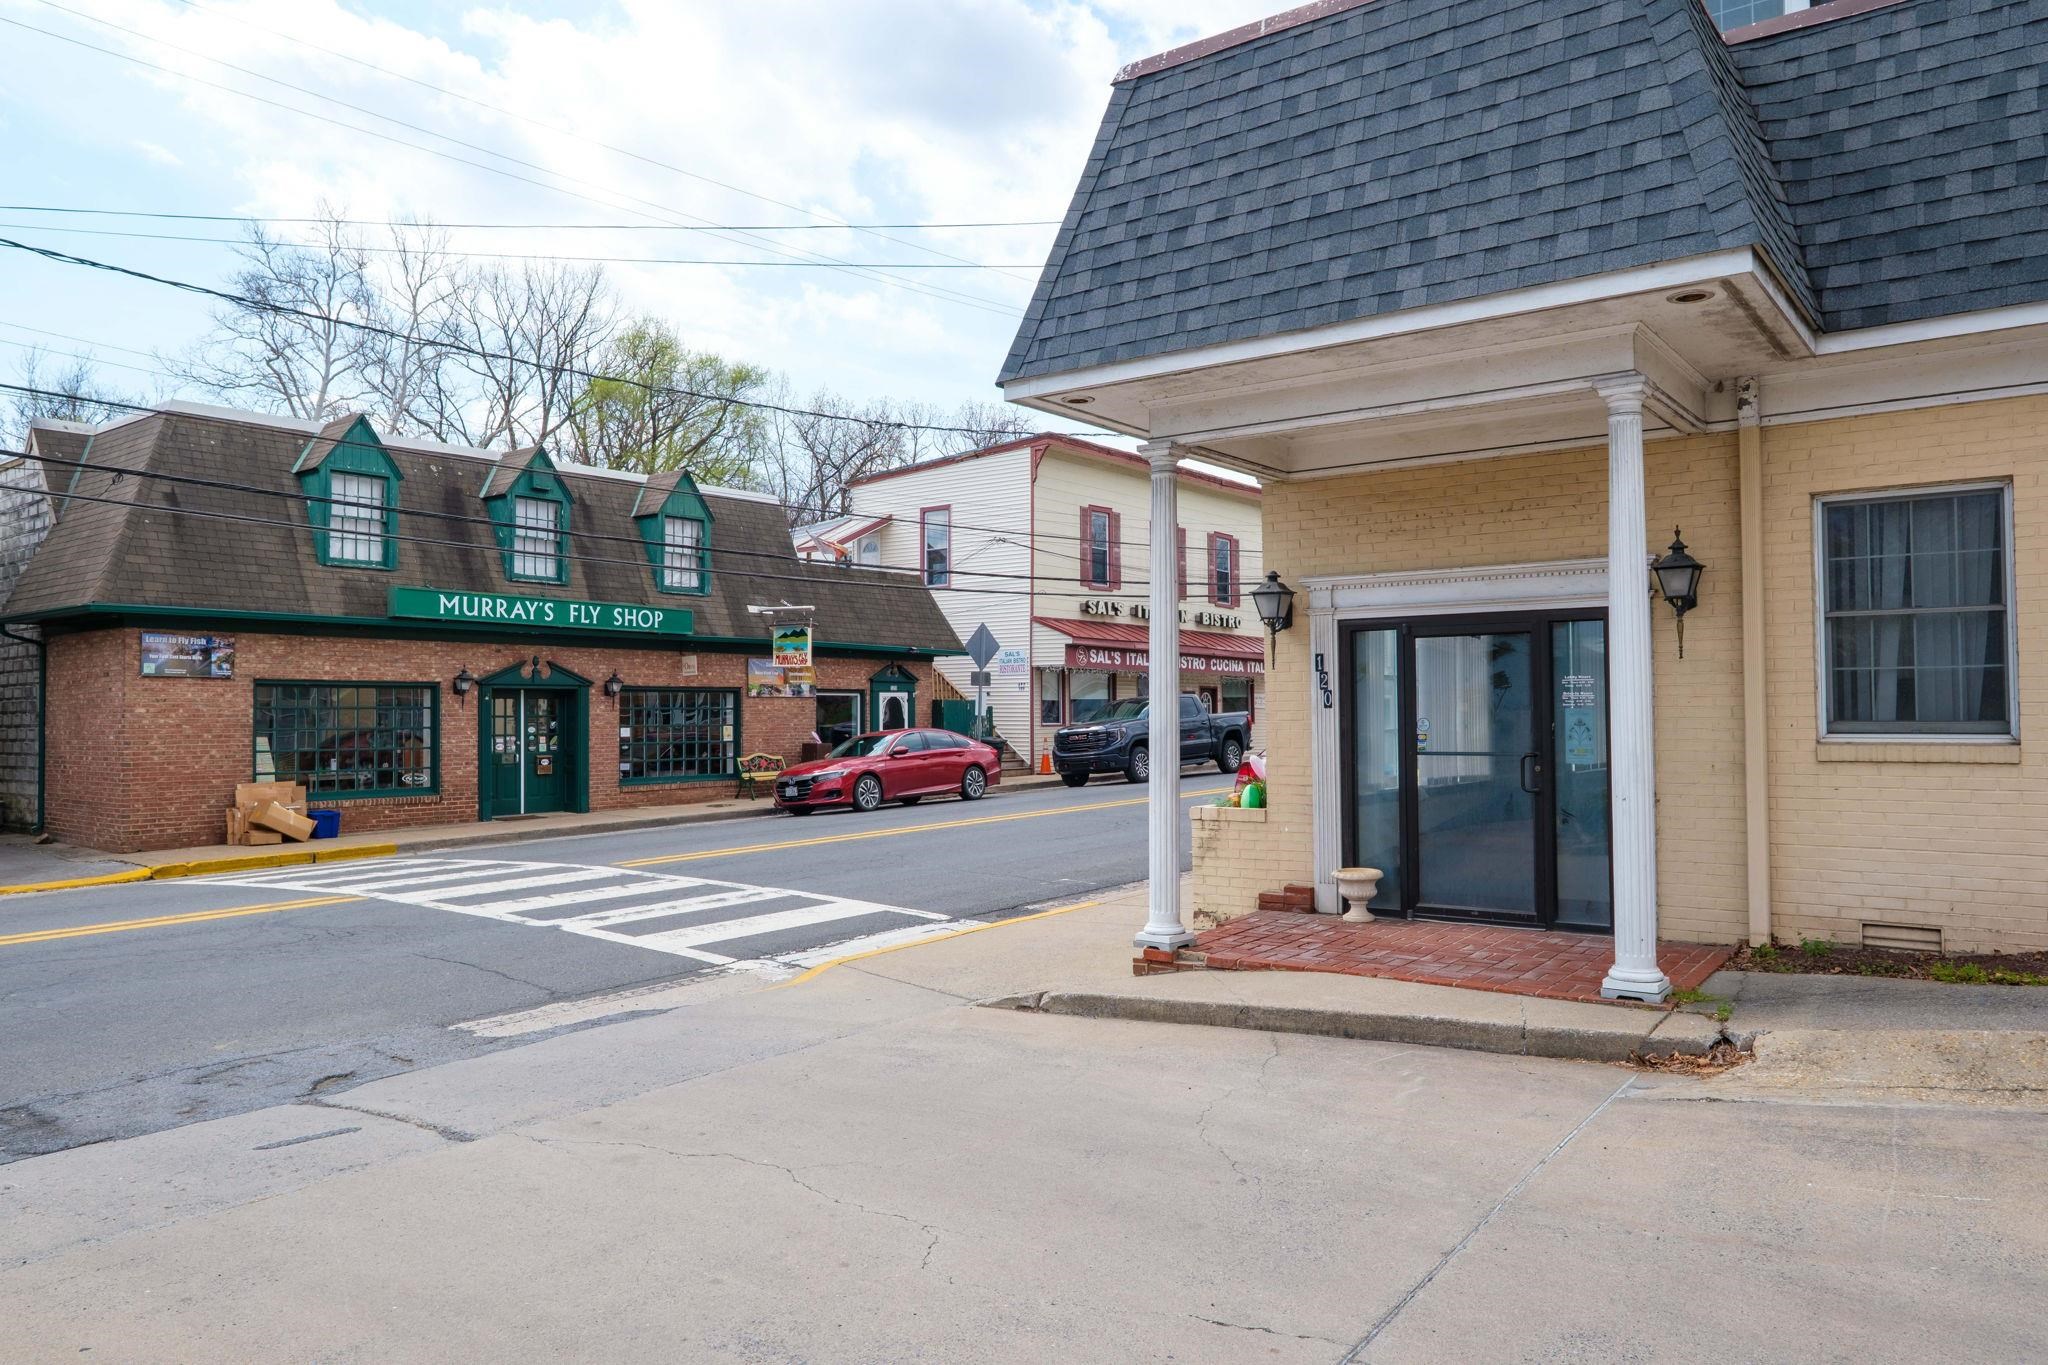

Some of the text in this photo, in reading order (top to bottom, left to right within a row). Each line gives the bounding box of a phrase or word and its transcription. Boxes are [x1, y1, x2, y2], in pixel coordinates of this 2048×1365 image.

[438, 594, 664, 628] MURRAY'S FLY SHOP
[1087, 600, 1124, 616] SAL'S
[1202, 612, 1242, 628] BISTRO
[145, 635, 207, 645] Learn to Fly Fish
[1089, 649, 1264, 673] SAL'S ITAL ISTRO CUCINA ITAL
[1316, 655, 1332, 706] 120
